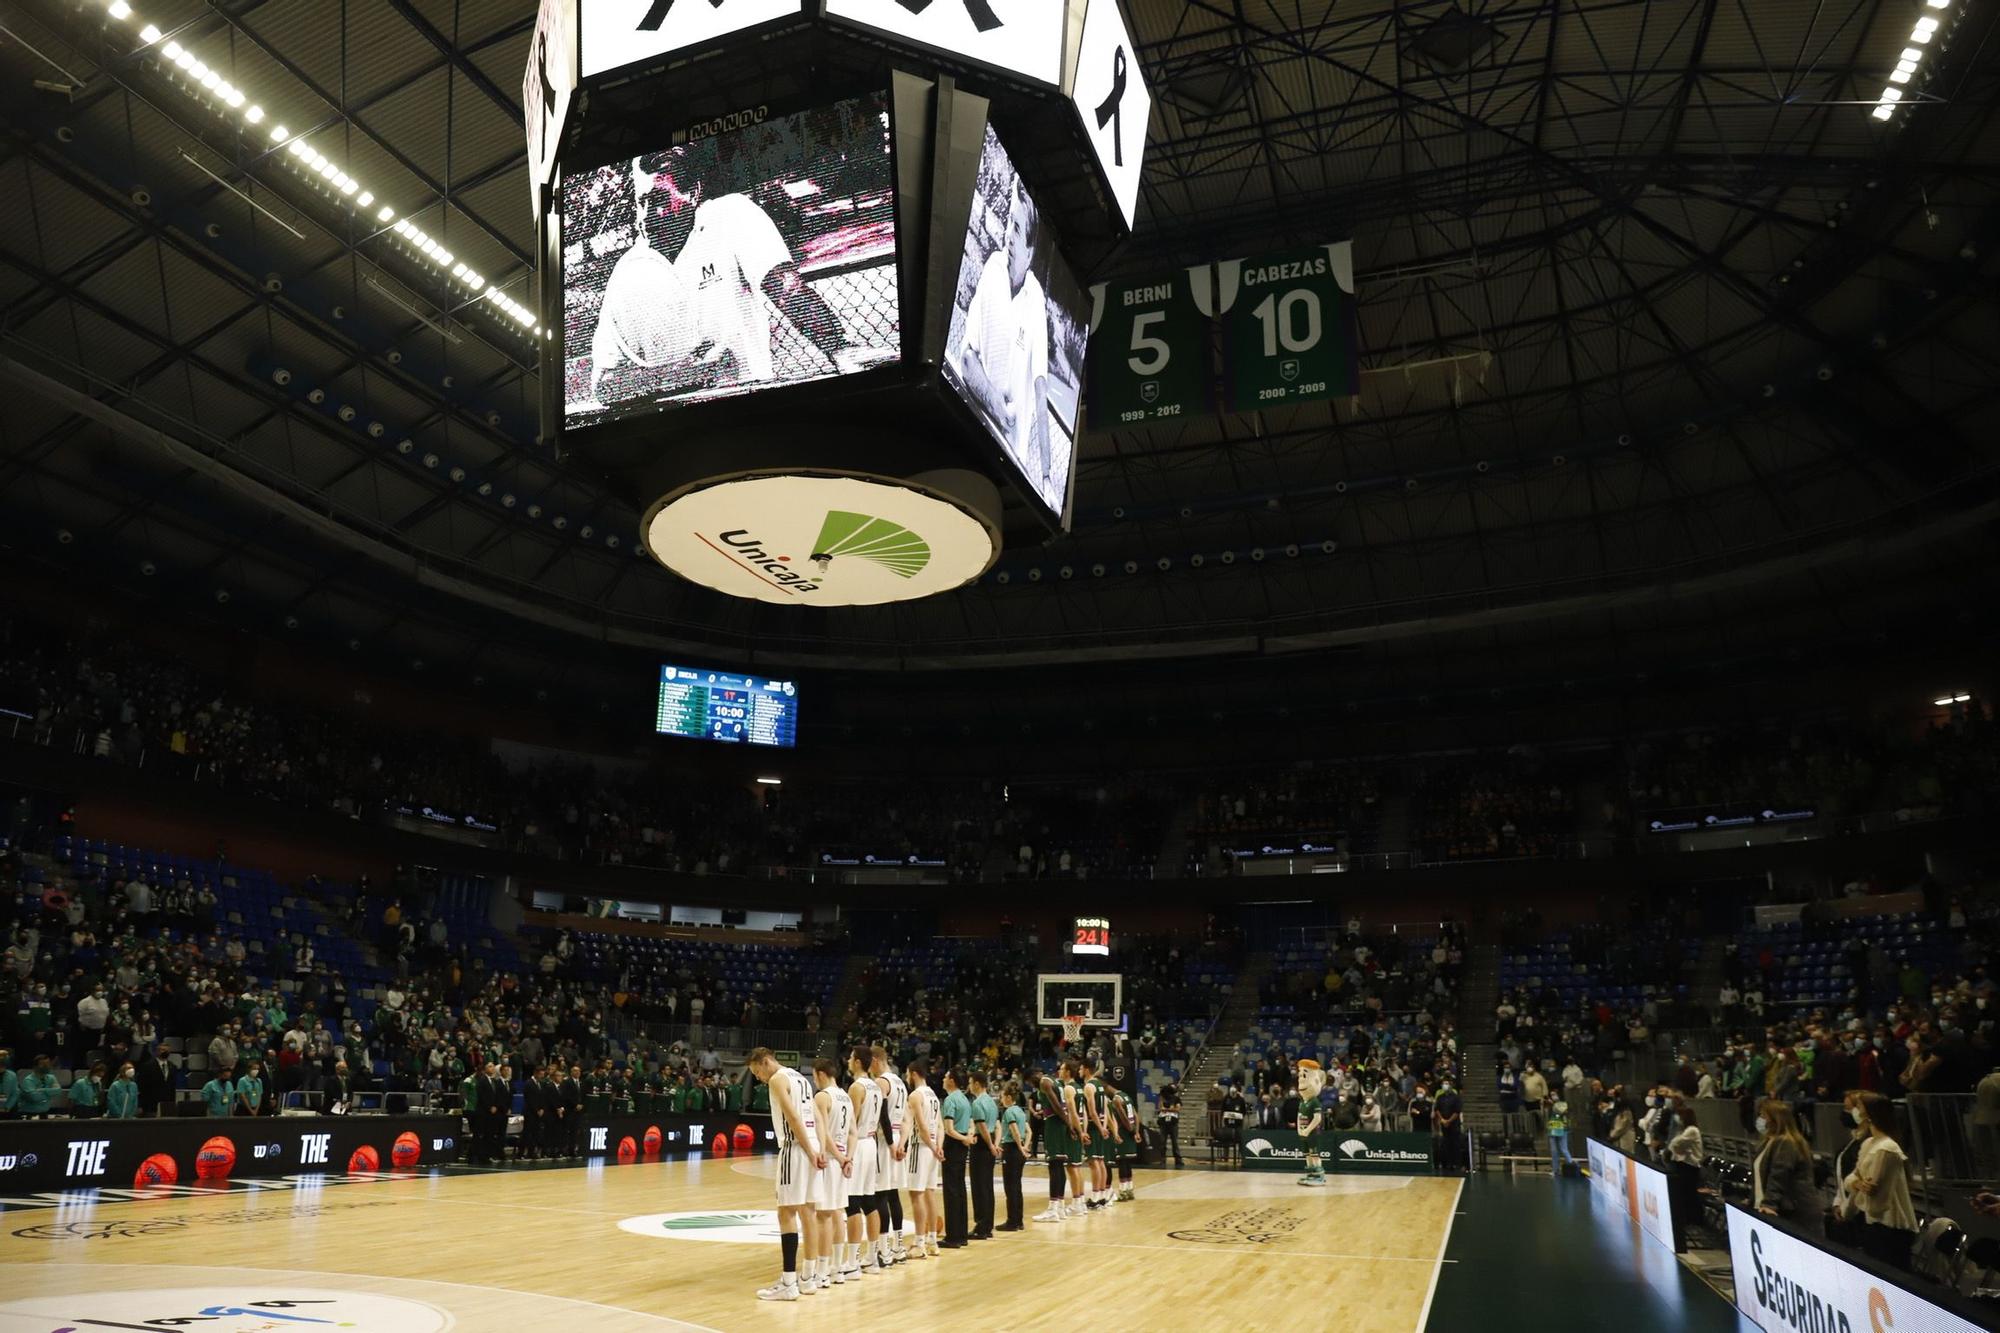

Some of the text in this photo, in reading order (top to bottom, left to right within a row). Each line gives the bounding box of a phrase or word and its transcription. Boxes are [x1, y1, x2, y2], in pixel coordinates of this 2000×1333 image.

[690, 105, 768, 141] MONDO
[1244, 258, 1327, 286] CABEZAS
[1123, 282, 1172, 306] BERNI
[1252, 288, 1322, 357] 10
[1127, 310, 1170, 376] 5
[1259, 387, 1286, 400] 2000
[1299, 382, 1326, 394] 2009
[1120, 410, 1145, 421] 1999
[1157, 404, 1181, 417] 2012
[719, 529, 819, 593] Unicaja
[715, 705, 744, 718] 10:00
[1076, 919, 1100, 927] 10:00
[1076, 929, 1097, 945] 24
[797, 1079, 811, 1102] 24
[841, 1105, 847, 1129] 3
[929, 1099, 939, 1120] 19
[589, 1127, 608, 1150] THE
[689, 1125, 704, 1145] THE
[66, 1140, 110, 1177] THE
[300, 1133, 331, 1164] THE
[1270, 1148, 1303, 1158] Unicaja
[1365, 1150, 1428, 1160] Unicaja Banco
